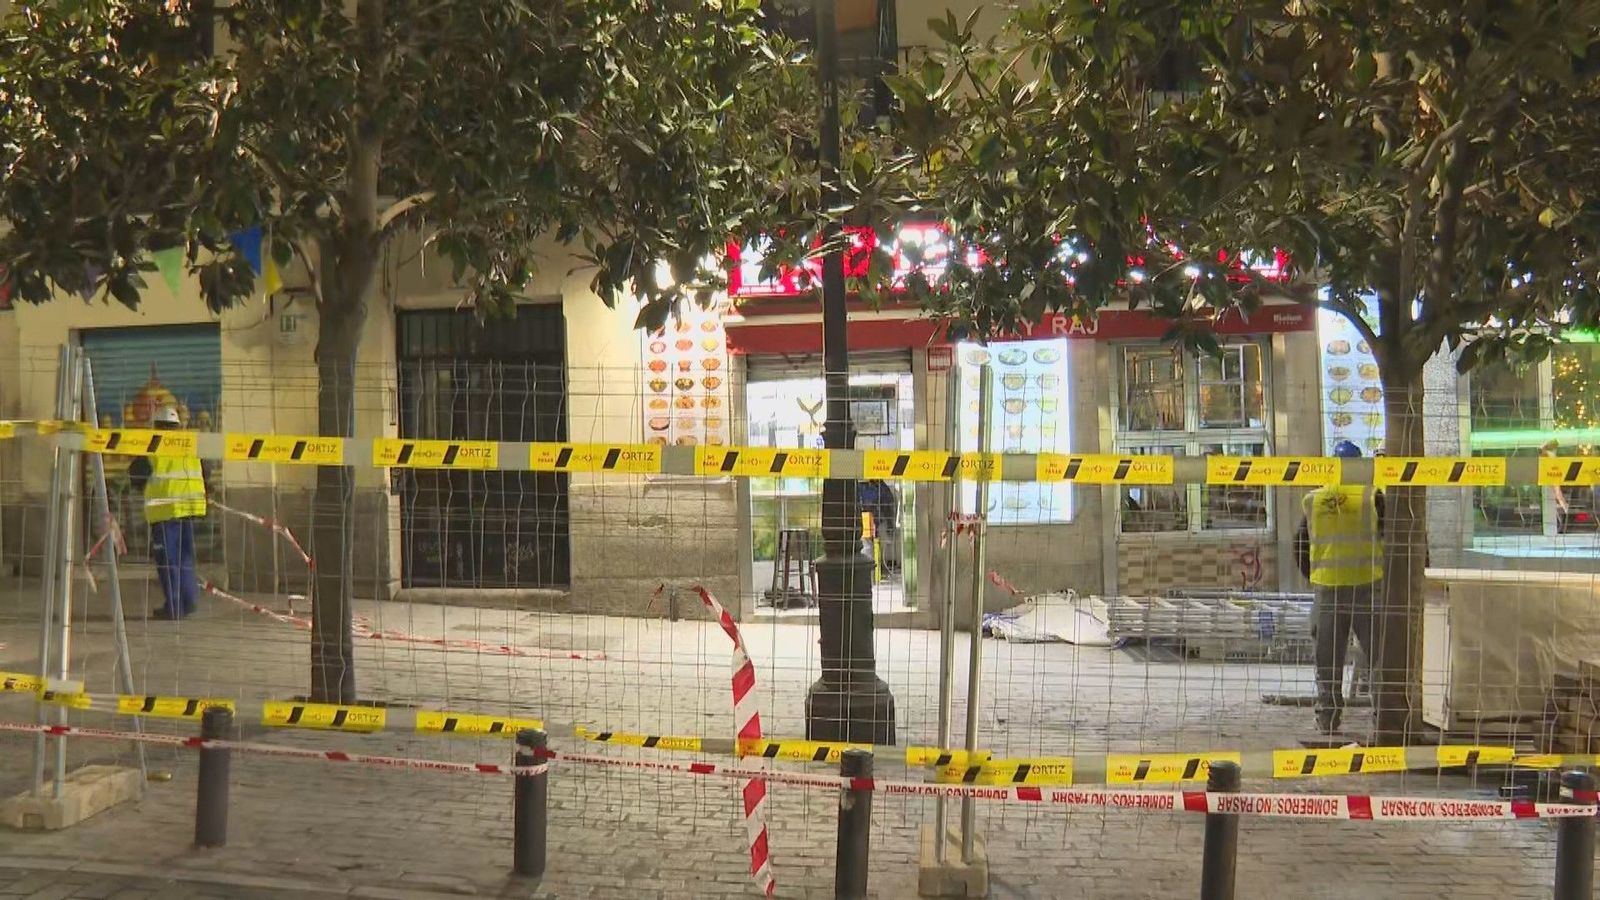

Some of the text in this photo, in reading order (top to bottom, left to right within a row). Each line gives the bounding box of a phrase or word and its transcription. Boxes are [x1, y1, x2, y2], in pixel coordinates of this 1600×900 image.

[1052, 315, 1098, 335] RAJ
[163, 437, 191, 448] ORTIZ
[306, 443, 336, 453] ORTIZ
[460, 447, 491, 458] ORTIZ
[621, 451, 654, 461] ORTIZ
[788, 455, 822, 466] ORTIZ
[960, 459, 995, 470] ORTIZ
[1132, 462, 1166, 472] ORTIZ
[1301, 464, 1334, 474] ORTIZ
[1466, 464, 1499, 474] ORTIZ
[349, 712, 379, 723] ORTIZ
[1032, 765, 1066, 775] ORTIZ
[1113, 794, 1174, 810] BOMBEROS
[1217, 796, 1338, 816] BOMBEROS NO PASAR
[1381, 800, 1504, 817] BOMBEROS NO PASAR
